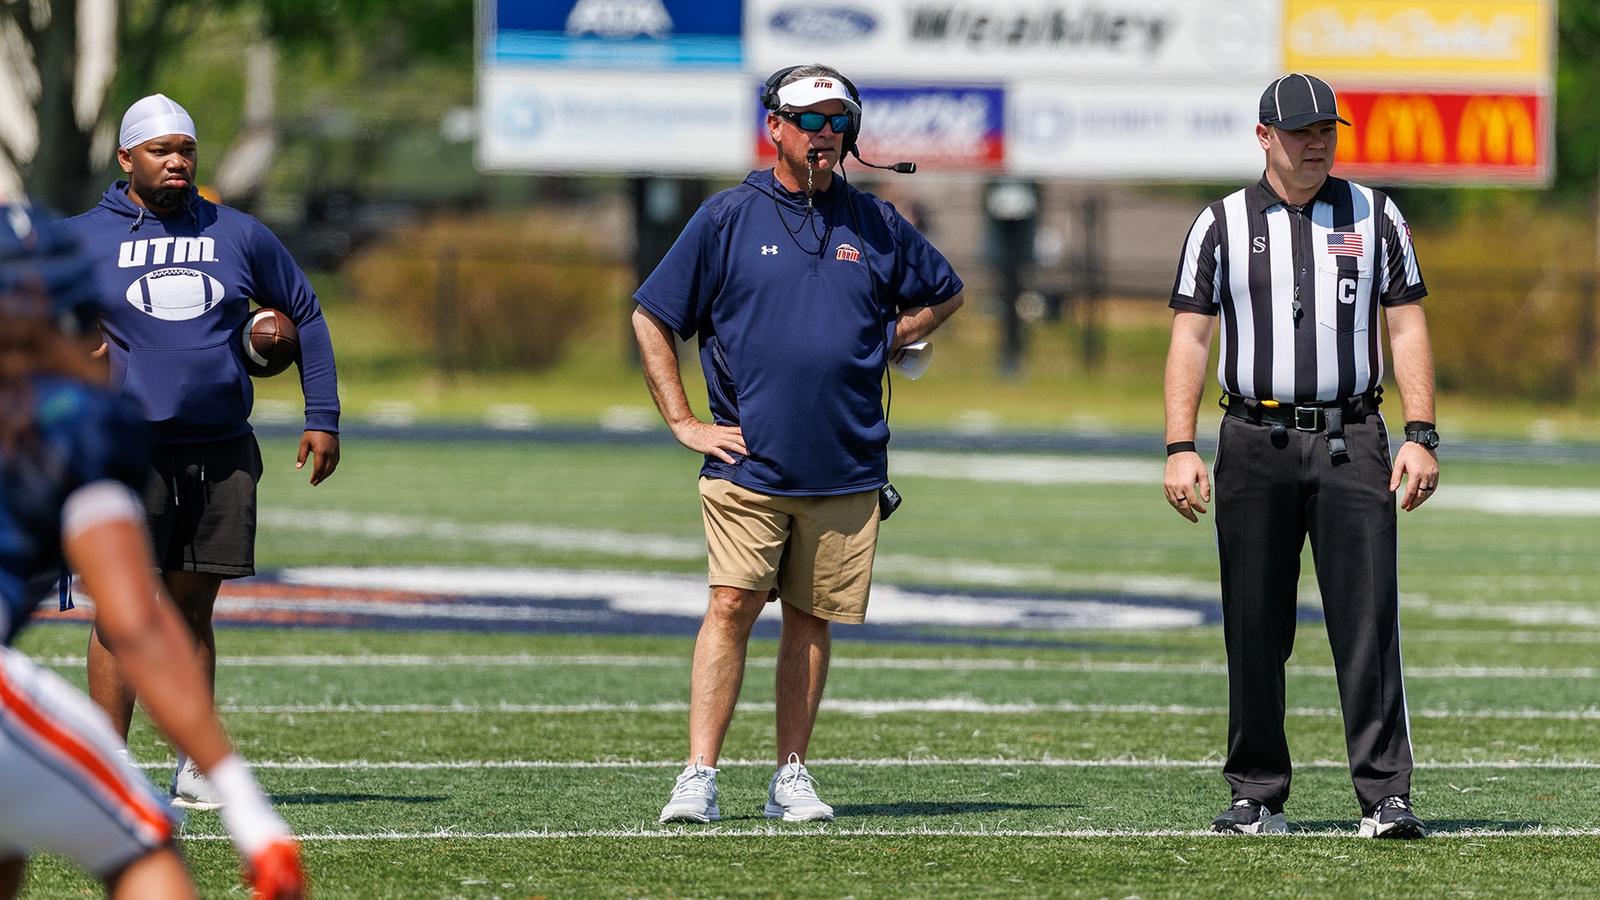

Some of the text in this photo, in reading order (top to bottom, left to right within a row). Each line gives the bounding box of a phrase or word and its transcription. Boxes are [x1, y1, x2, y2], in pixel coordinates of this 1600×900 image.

[908, 7, 1170, 58] Weakley
[814, 81, 833, 89] UTM
[118, 236, 216, 268] UTM
[1252, 236, 1266, 254] S
[1338, 278, 1356, 304] C
